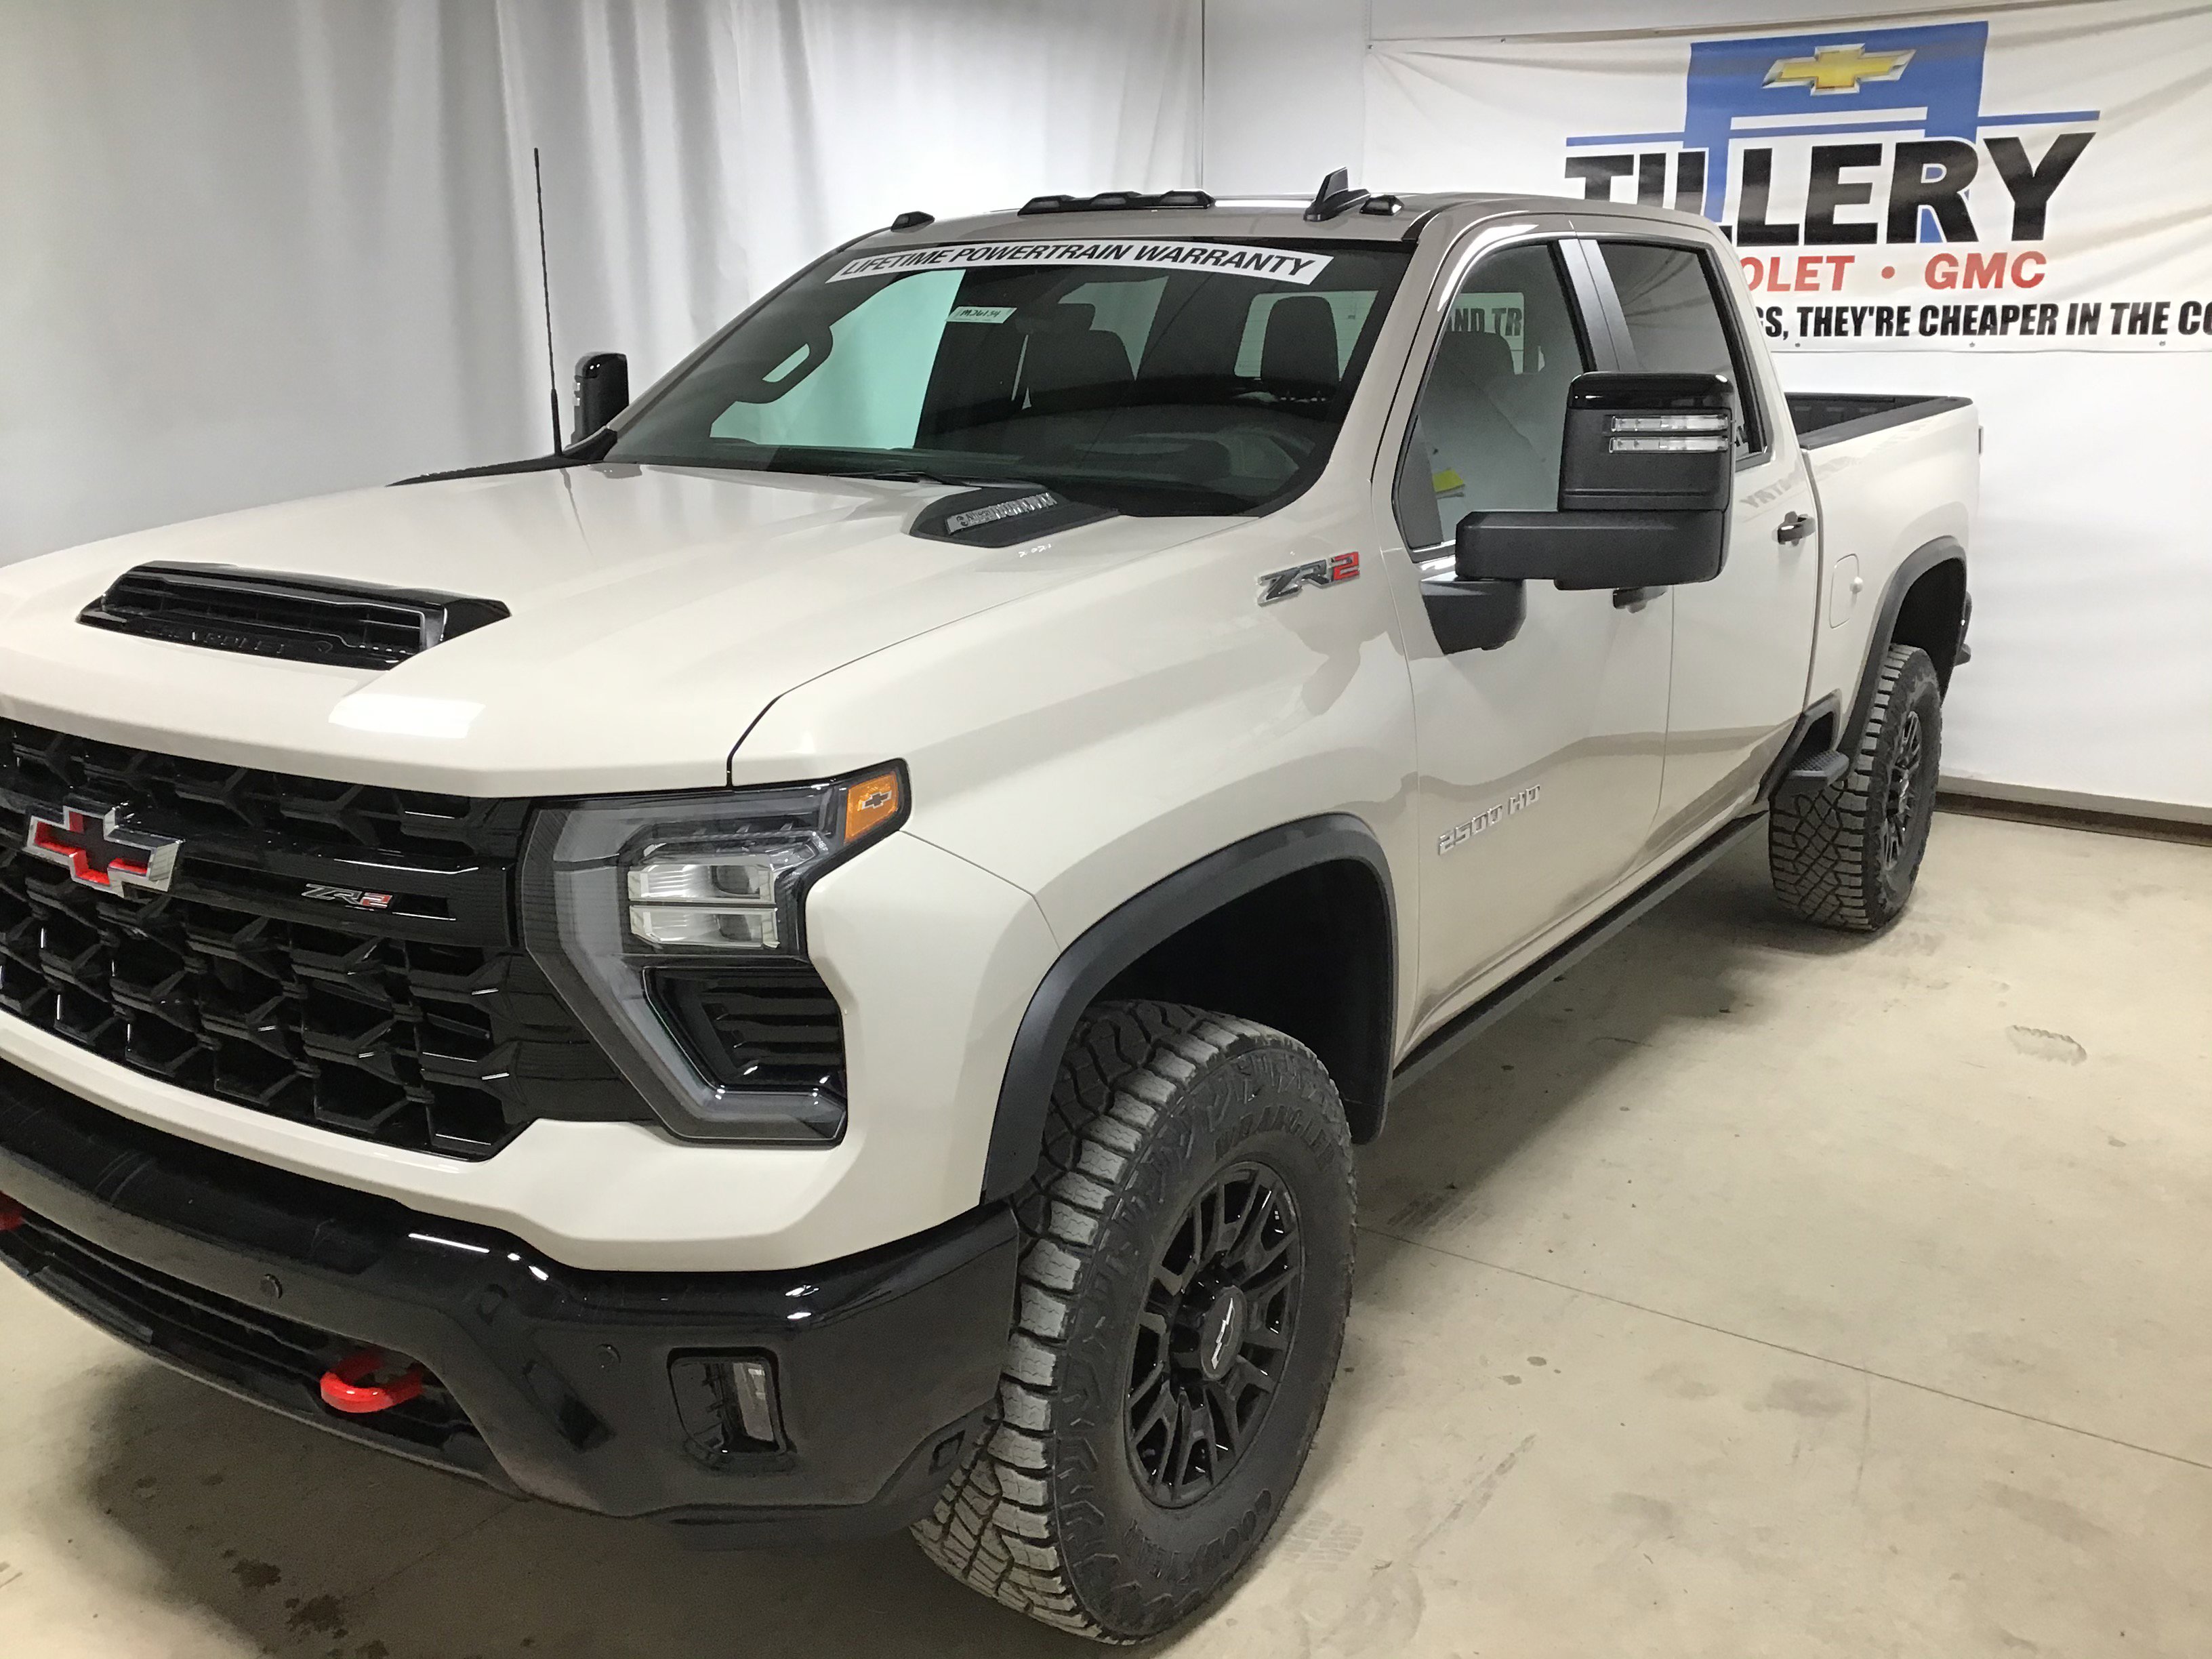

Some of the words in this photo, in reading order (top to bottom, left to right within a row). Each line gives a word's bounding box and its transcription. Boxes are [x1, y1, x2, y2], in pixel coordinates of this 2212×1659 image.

[1564, 131, 2097, 248] TILLERY
[840, 249, 954, 276] LIFETIME
[949, 244, 1136, 264] POWERTRAIN
[1133, 244, 1316, 276] WARRANTY
[1739, 255, 1856, 291] OLET
[1924, 250, 2047, 290] GMC
[1797, 305, 1912, 337] THEY'RE
[1918, 303, 2060, 337] CHEAPER
[2065, 302, 2102, 336] IN
[2110, 301, 2171, 335] THE
[1256, 551, 1361, 607] ZR2
[1437, 804, 1503, 856] 2500
[1508, 784, 1541, 815] HD
[302, 884, 393, 909] ZR2
